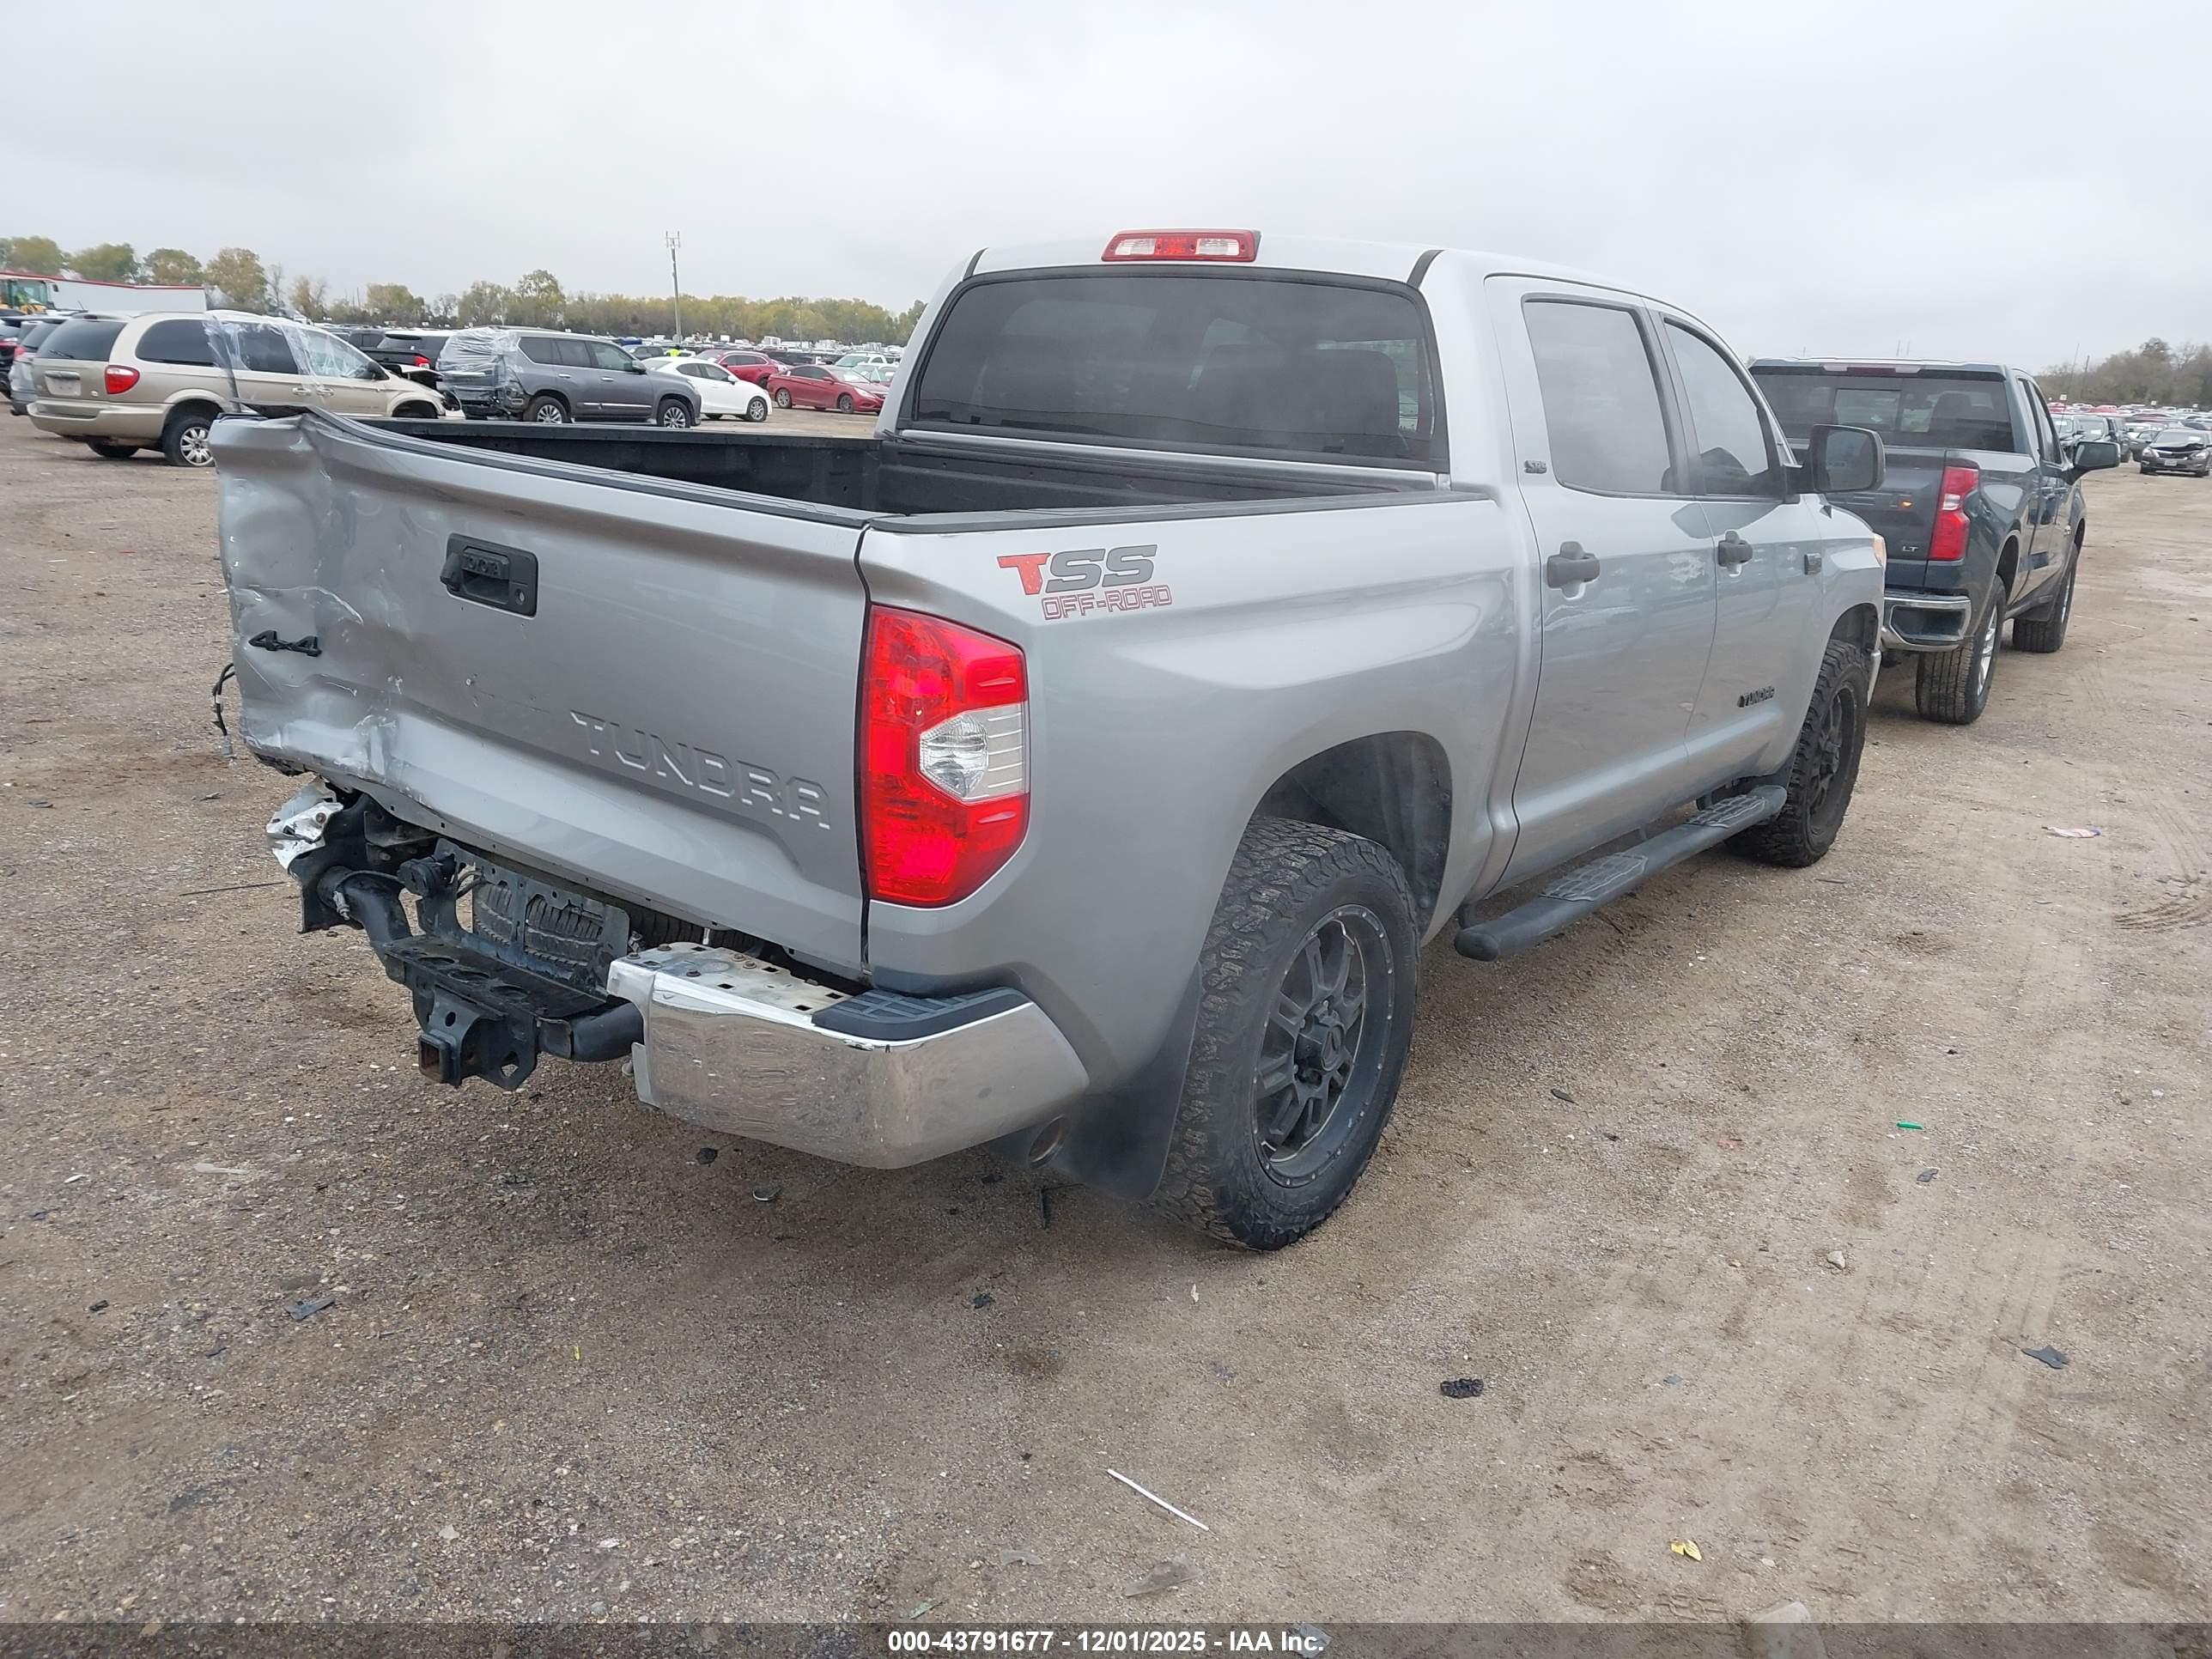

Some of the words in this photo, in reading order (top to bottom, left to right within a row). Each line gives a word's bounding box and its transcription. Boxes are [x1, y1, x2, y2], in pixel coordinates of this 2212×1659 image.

[997, 544, 1158, 595] TSS
[1042, 585, 1173, 620] OFF-ROAD
[570, 709, 830, 830] TUNDRA
